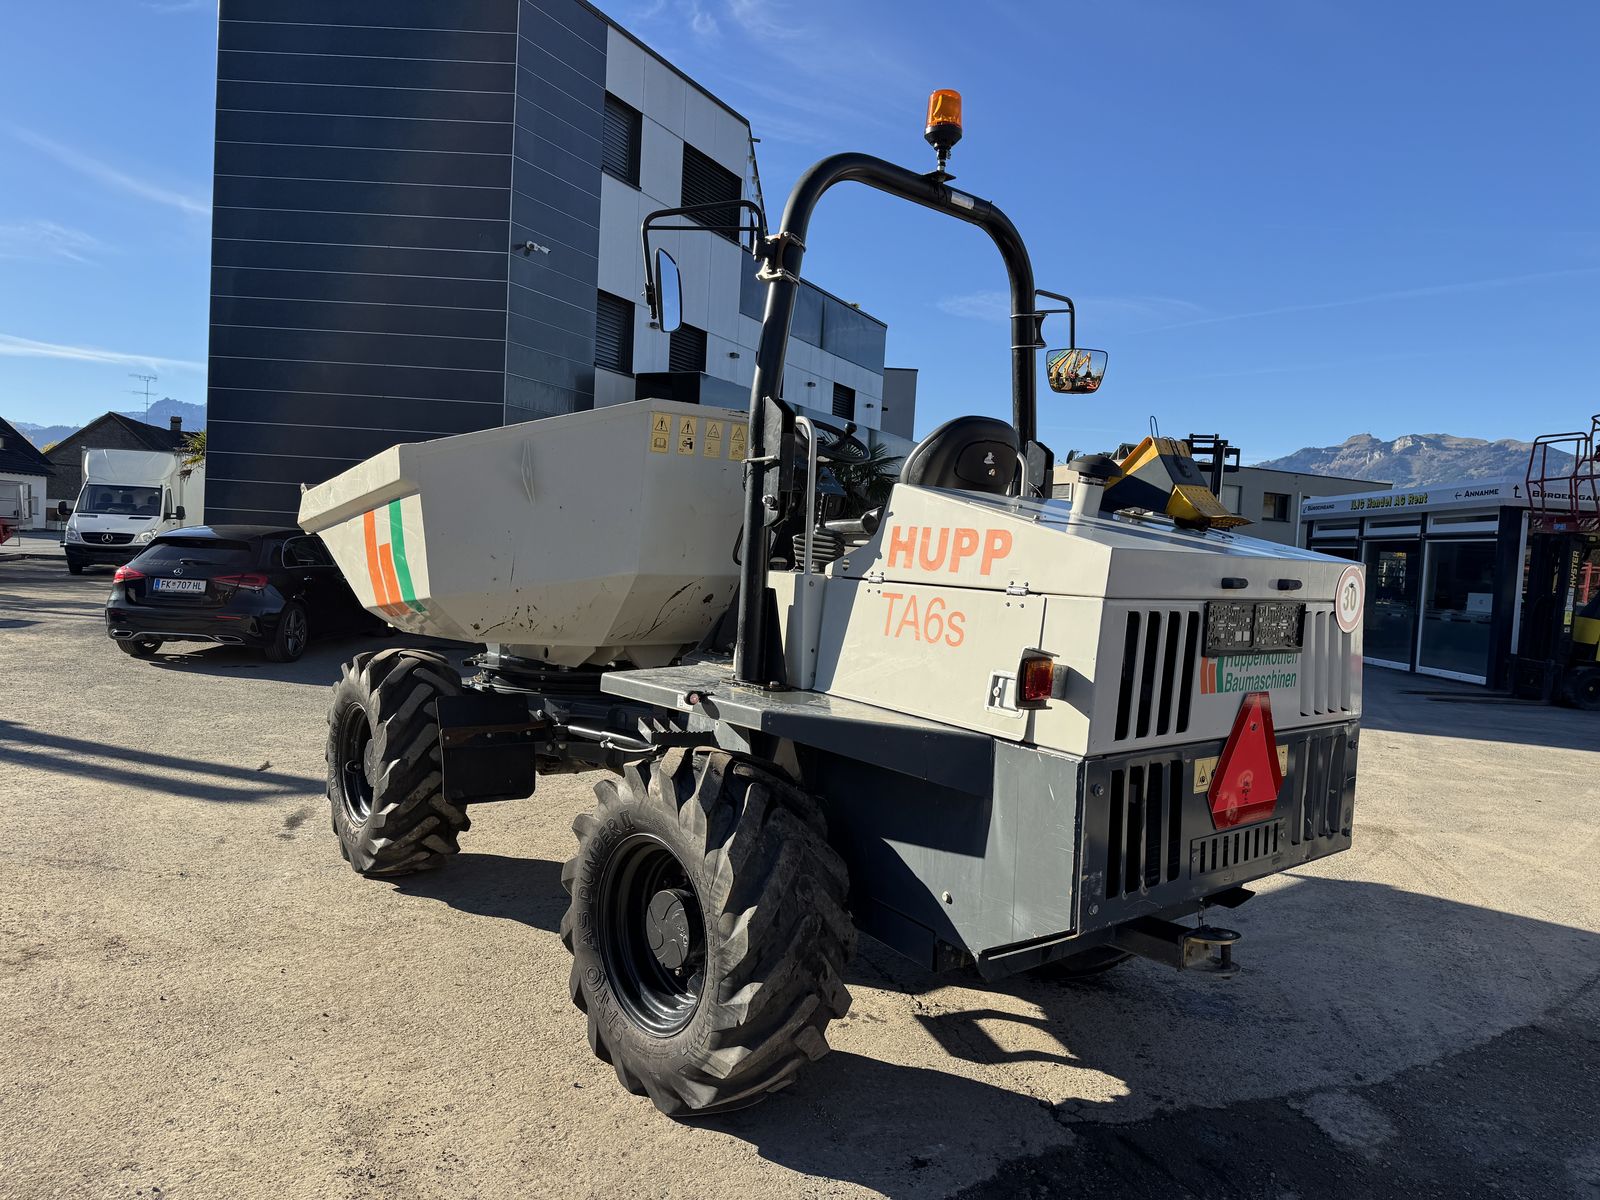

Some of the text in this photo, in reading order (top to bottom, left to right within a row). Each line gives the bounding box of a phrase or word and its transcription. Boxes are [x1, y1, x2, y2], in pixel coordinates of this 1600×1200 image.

[1464, 489, 1499, 498] ANNAHME
[887, 525, 1013, 576] HUPP
[1569, 550, 1580, 588] HYSTER
[160, 580, 172, 589] FK
[176, 580, 192, 590] 707
[1343, 586, 1357, 612] 30
[882, 592, 966, 647] TA6s
[1224, 670, 1297, 692] Baumaschinen
